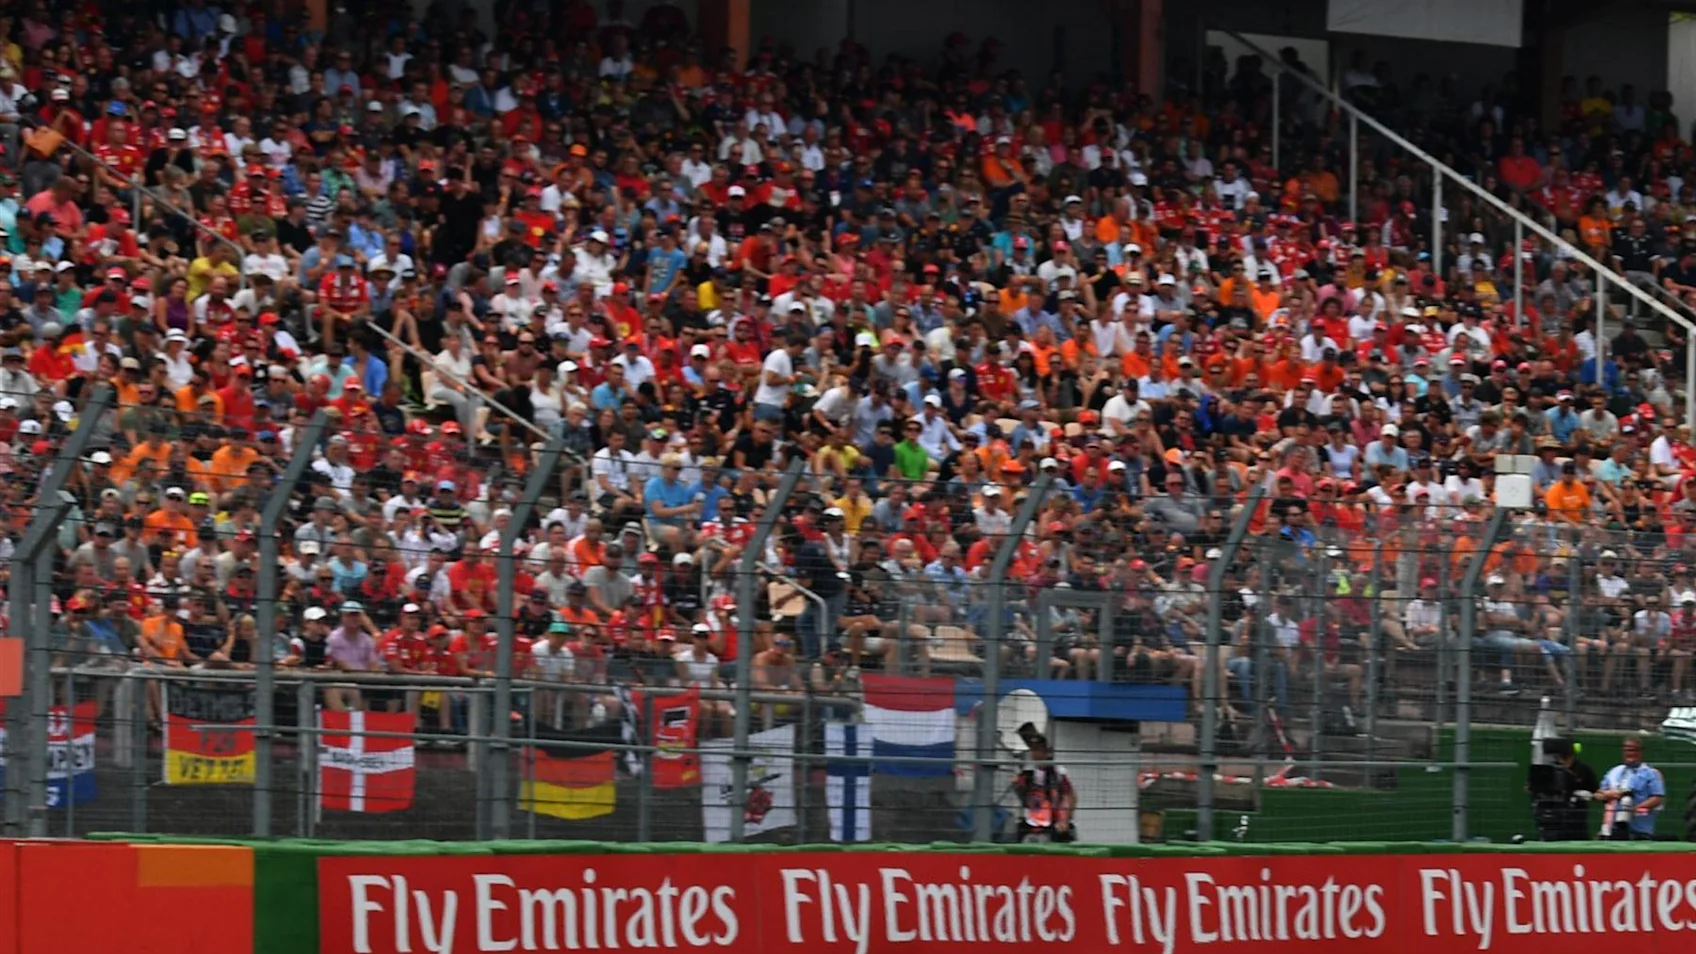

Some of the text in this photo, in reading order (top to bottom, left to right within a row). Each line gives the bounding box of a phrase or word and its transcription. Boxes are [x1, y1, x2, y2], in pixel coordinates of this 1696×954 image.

[473, 867, 739, 951] Emirates
[879, 865, 1076, 943] Emirates
[1184, 871, 1385, 943] Emirates
[1419, 867, 1495, 951] Fly
